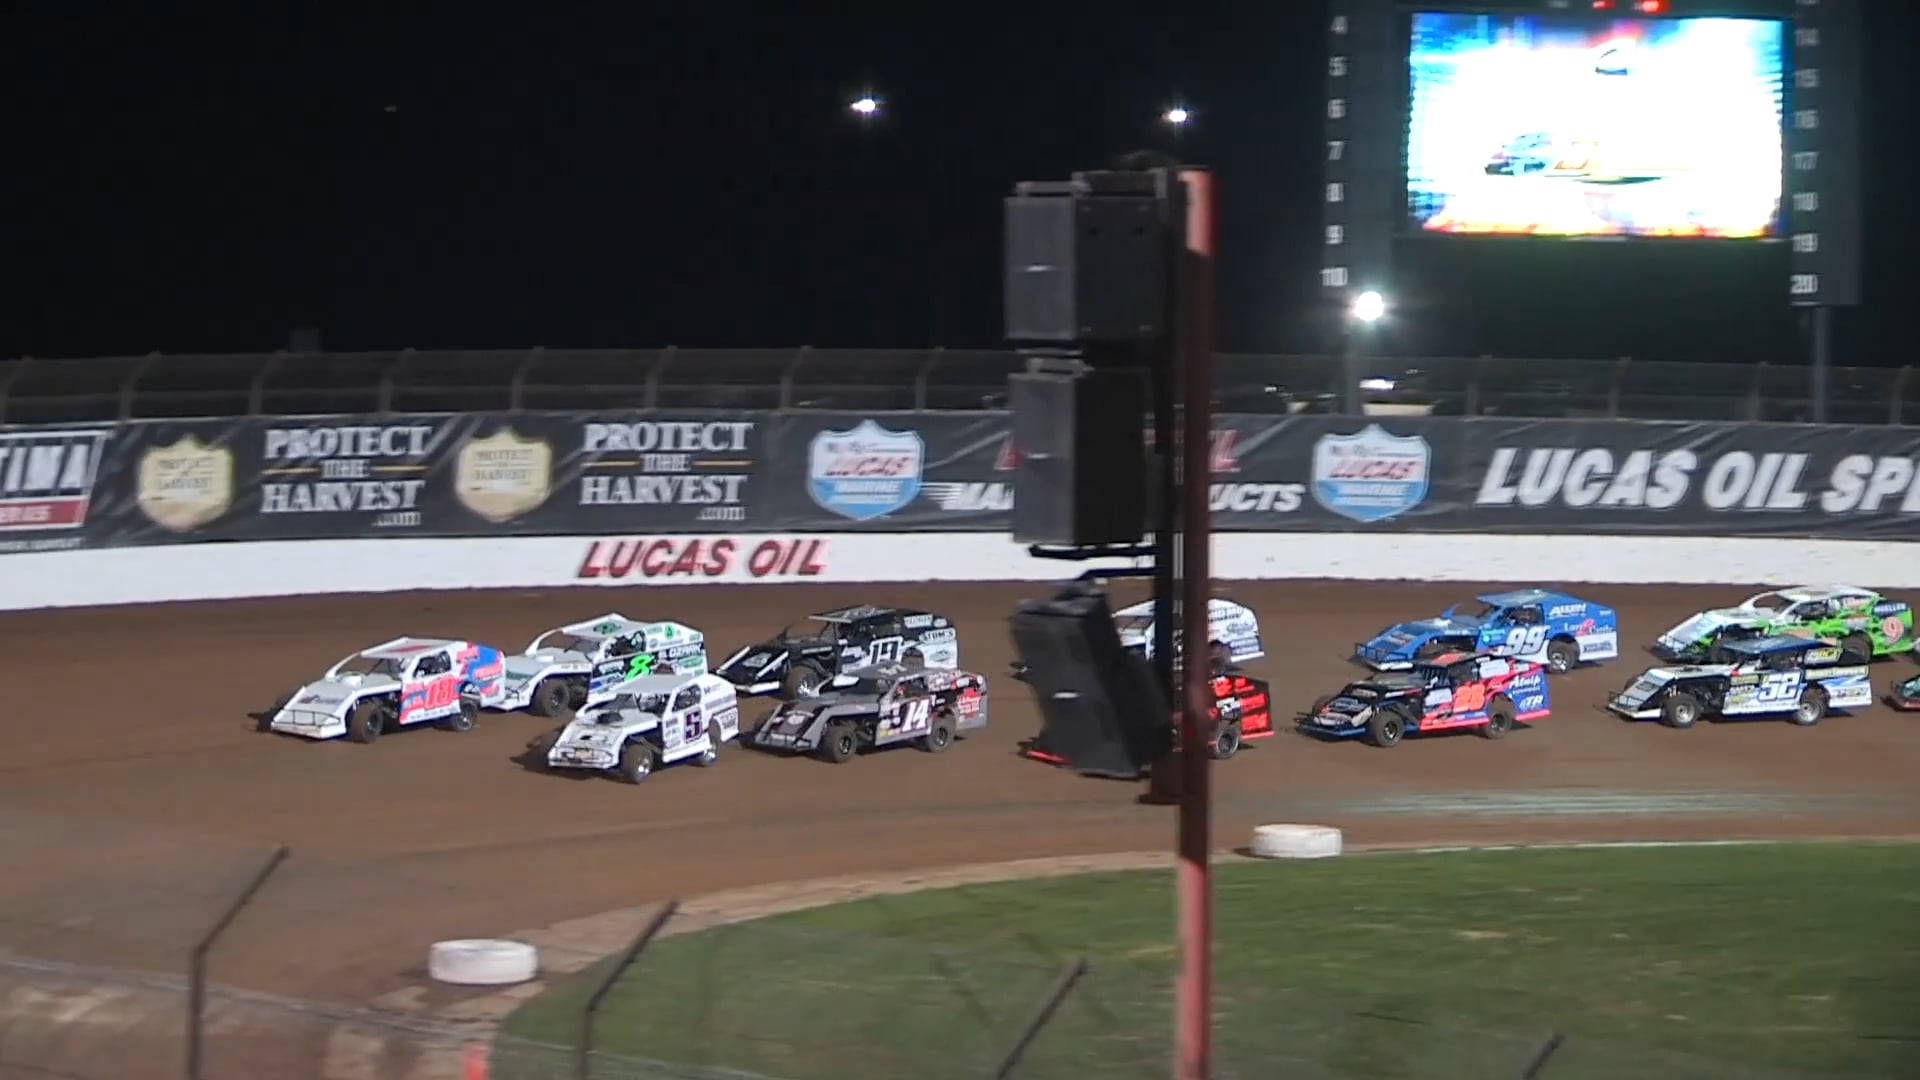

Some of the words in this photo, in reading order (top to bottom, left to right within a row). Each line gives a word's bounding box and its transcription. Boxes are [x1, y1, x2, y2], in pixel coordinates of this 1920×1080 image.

[1331, 15, 1348, 34] 4
[1328, 57, 1347, 76] 5
[1327, 99, 1346, 118] 6
[1327, 141, 1344, 160] 7
[1793, 152, 1818, 169] 17
[1325, 183, 1344, 202] 8
[1793, 193, 1819, 210] 18
[1325, 225, 1344, 244] 9
[1793, 233, 1818, 252] 19
[1320, 267, 1348, 287] 10
[1790, 275, 1818, 294] 20
[264, 426, 432, 459] PROTECT
[584, 422, 755, 451] PROTECT
[319, 459, 370, 478] THE
[639, 453, 691, 472] THE
[579, 474, 748, 505] HARVEST
[1476, 447, 1698, 508] LUCAS
[1703, 451, 1812, 510] OIL
[260, 480, 425, 513] HARVEST
[1208, 482, 1306, 512] UCTS
[577, 539, 736, 579] LUCAS
[748, 539, 829, 579] OIL
[1502, 625, 1546, 655] 99
[1883, 617, 1904, 644] 9
[624, 653, 655, 682] 8
[424, 674, 458, 711] 18
[1759, 671, 1801, 702] 52
[683, 707, 703, 743] 5
[901, 698, 930, 732] 14
